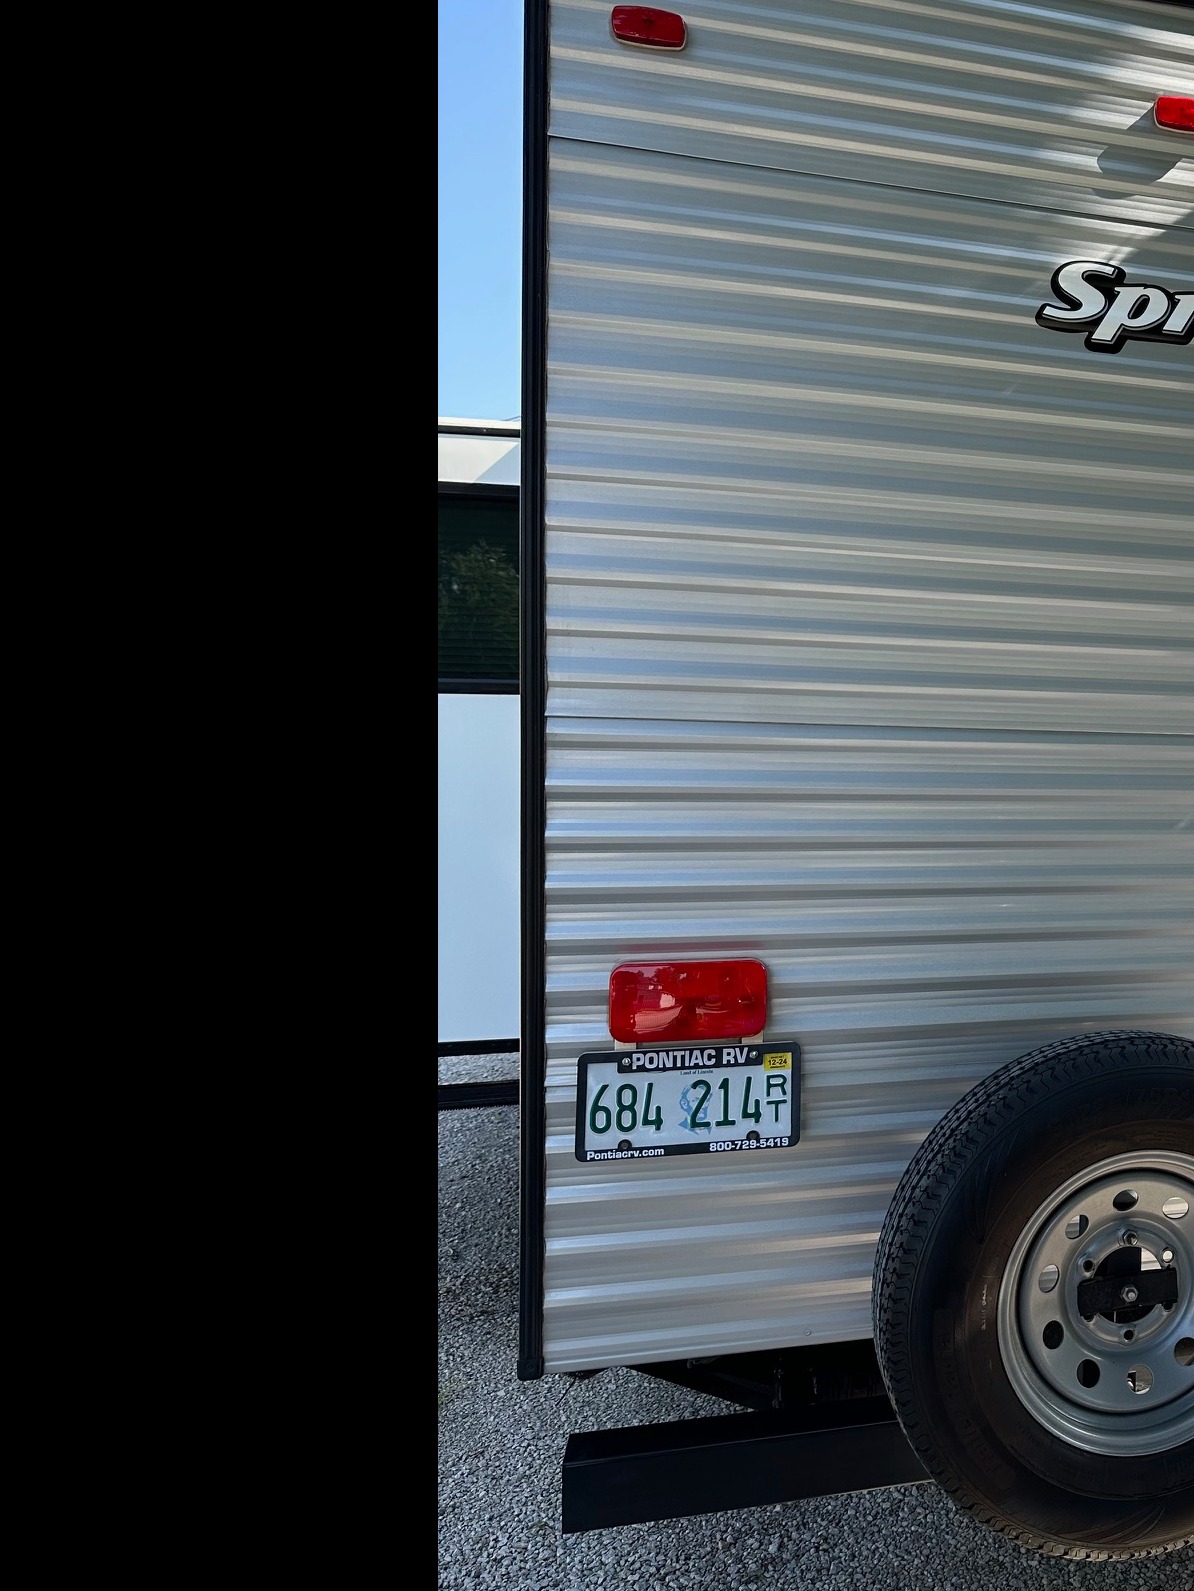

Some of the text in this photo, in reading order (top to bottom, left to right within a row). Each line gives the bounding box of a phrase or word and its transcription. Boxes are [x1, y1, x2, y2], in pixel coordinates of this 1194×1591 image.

[632, 1047, 748, 1070] PONTIAC RV
[768, 1058, 787, 1066] 12-24
[589, 1076, 762, 1135] 684 214
[709, 1137, 789, 1152] 800-729-5419
[587, 1148, 665, 1161] Pontiacrv.com
